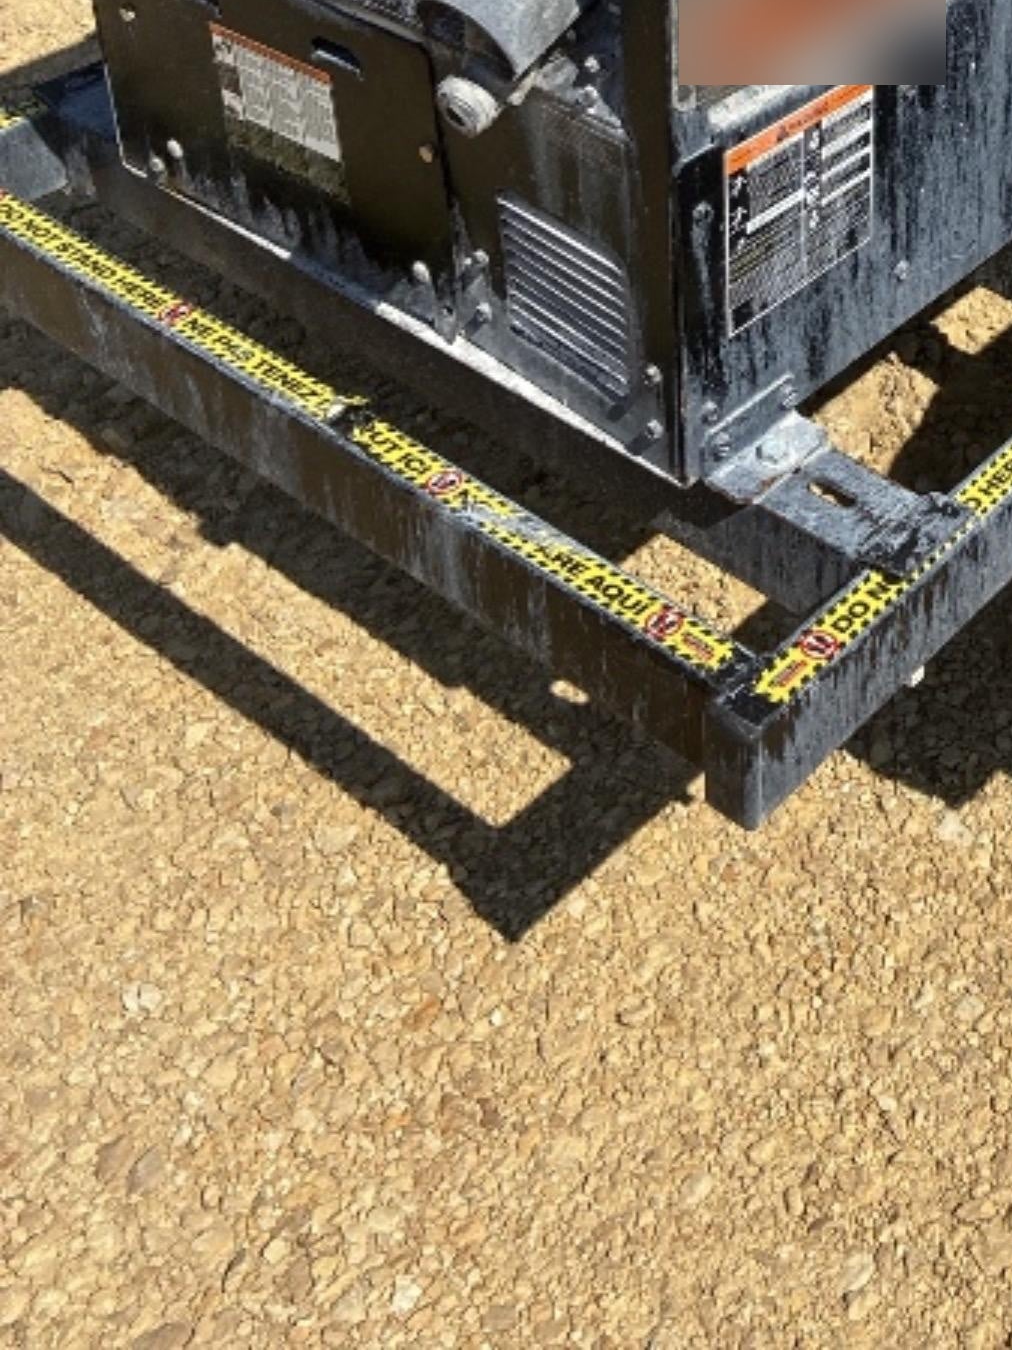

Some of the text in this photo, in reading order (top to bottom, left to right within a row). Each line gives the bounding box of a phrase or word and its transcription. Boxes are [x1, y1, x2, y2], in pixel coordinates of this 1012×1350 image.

[56, 242, 118, 280] STAND
[111, 275, 169, 309] HERE
[583, 575, 649, 616] AQUI
[830, 601, 871, 634] DO
